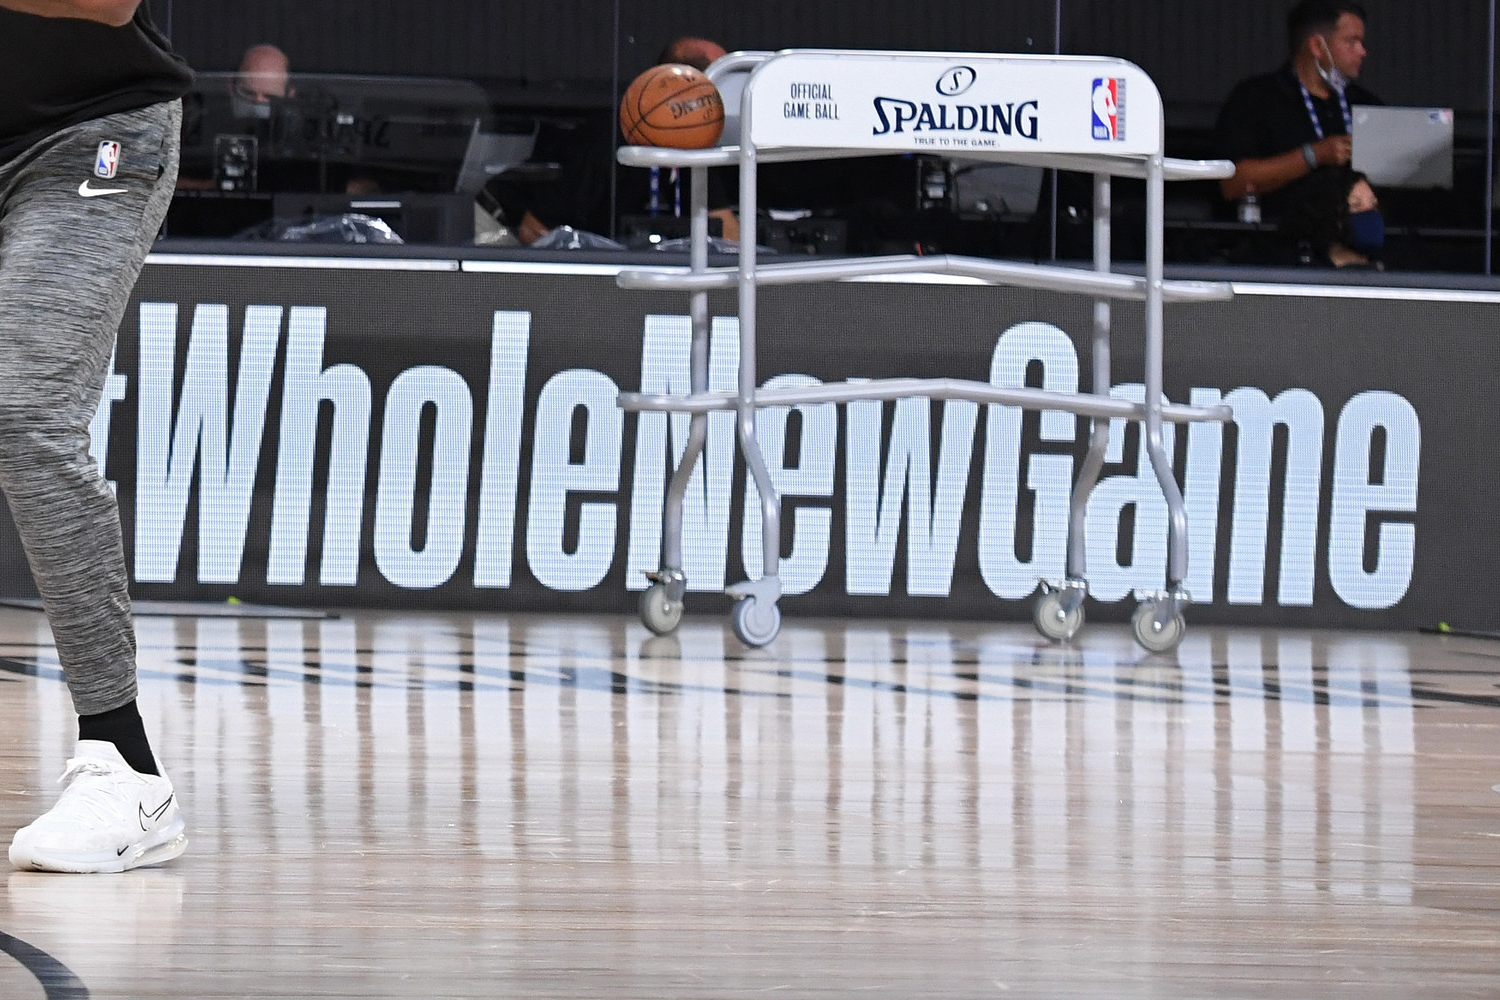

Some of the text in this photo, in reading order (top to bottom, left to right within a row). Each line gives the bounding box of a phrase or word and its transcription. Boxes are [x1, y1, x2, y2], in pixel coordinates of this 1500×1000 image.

[790, 83, 834, 101] OFFICIAL
[783, 102, 841, 121] GAME BALL
[872, 96, 1039, 141] SPALDING
[913, 136, 936, 146] TRUE
[939, 137, 950, 147] TO
[953, 138, 968, 147] THE
